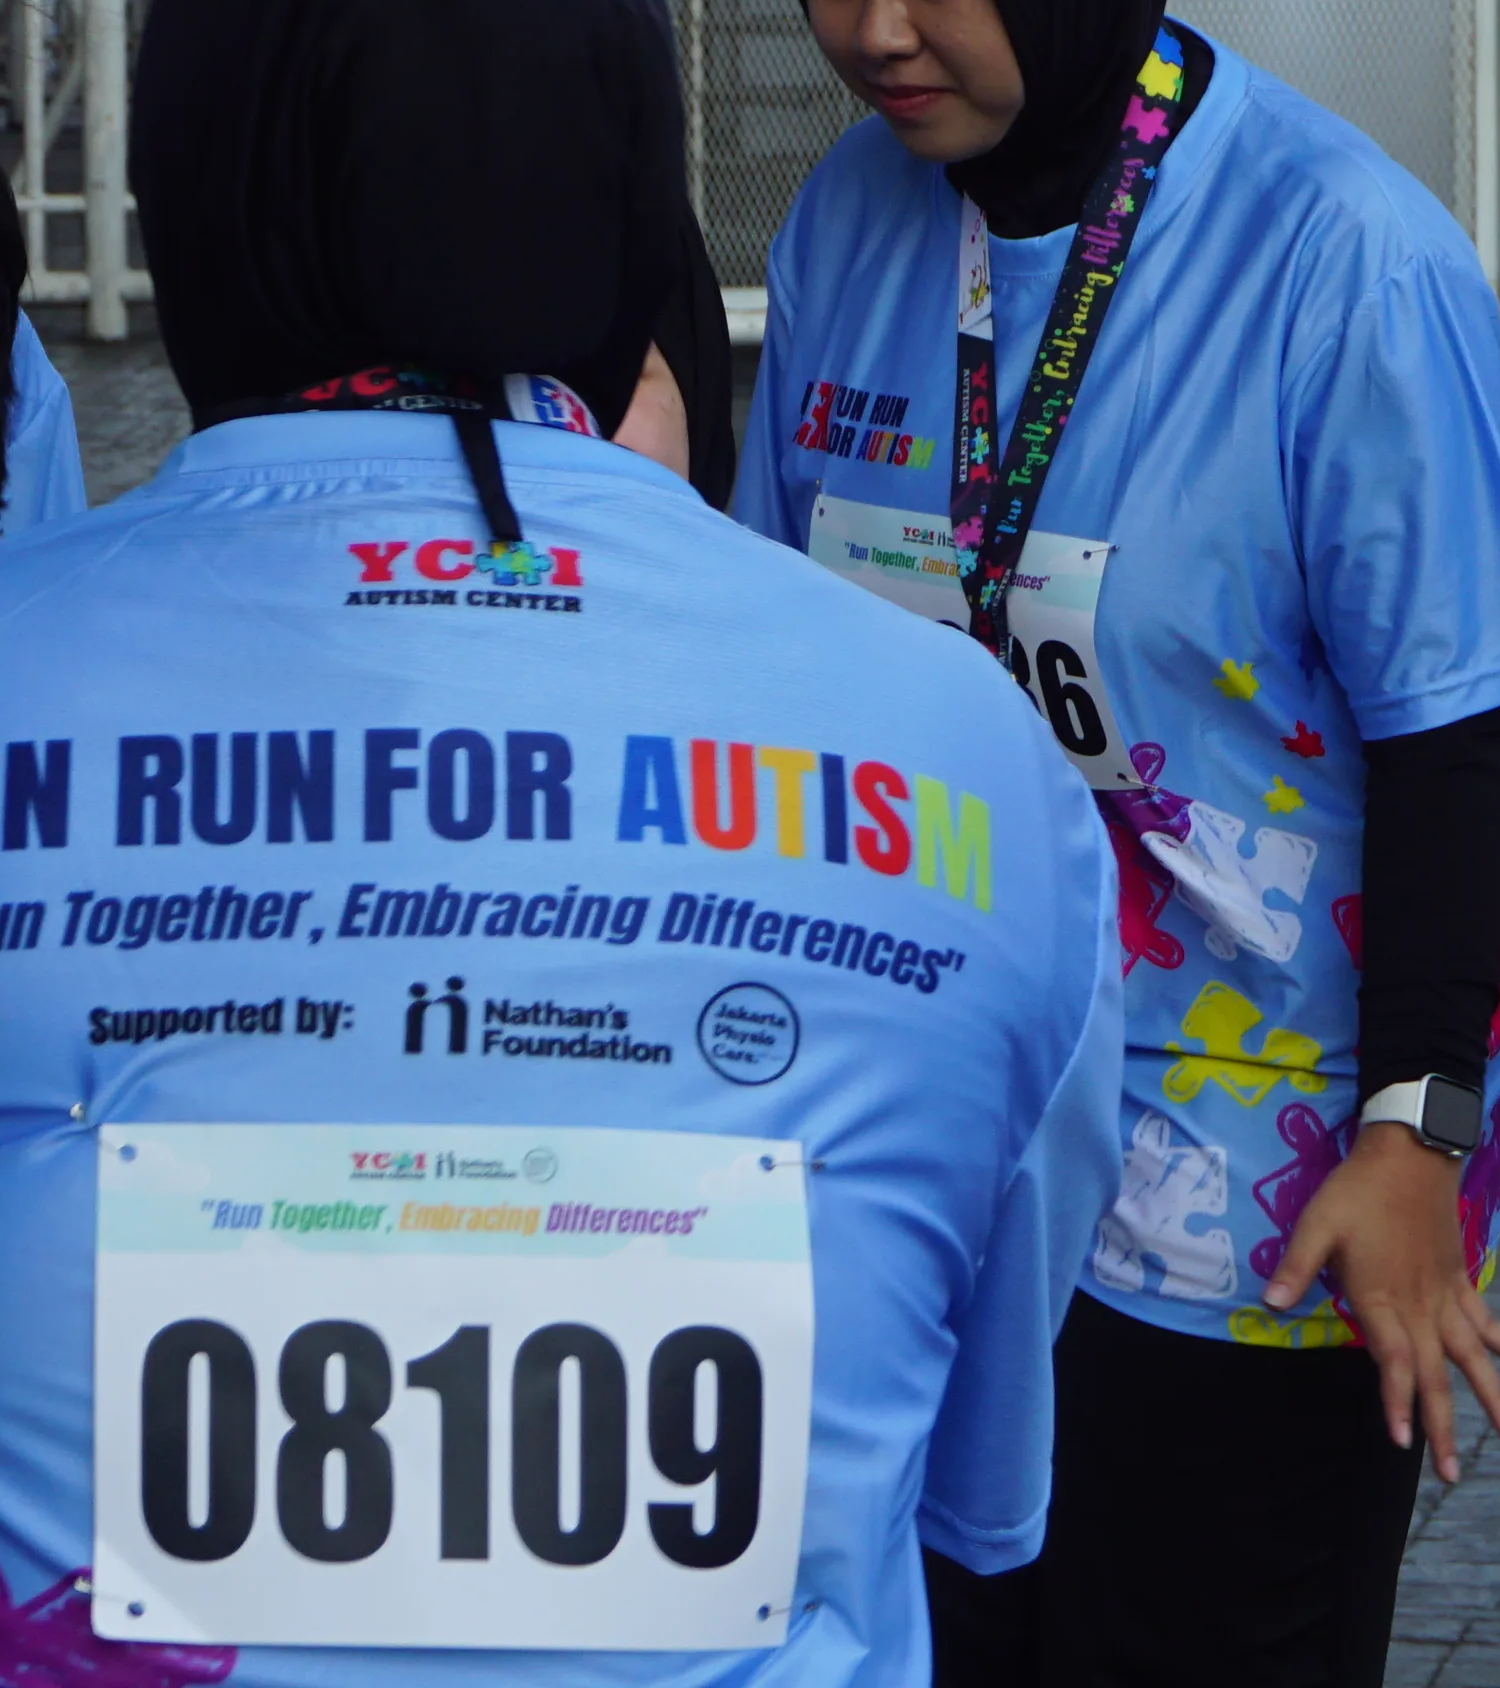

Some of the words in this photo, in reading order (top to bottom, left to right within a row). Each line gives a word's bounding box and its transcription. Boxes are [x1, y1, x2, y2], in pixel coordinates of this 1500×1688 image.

[855, 429, 937, 471] AUTISM
[344, 590, 458, 606] AUTISM
[465, 590, 583, 613] CENTER
[114, 728, 336, 847] RUN
[363, 728, 574, 842] FOR
[615, 733, 993, 914] AUTISM
[336, 882, 651, 946] Embracing
[657, 892, 967, 996] Differences"
[88, 996, 284, 1046] Supported
[294, 995, 356, 1040] by:
[483, 997, 630, 1031] Nathan's
[483, 1028, 673, 1065] Foundation
[201, 1199, 263, 1230] "Run
[401, 1201, 540, 1236] Embracing
[544, 1201, 708, 1235] Differences"
[139, 1317, 764, 1570] 08109
